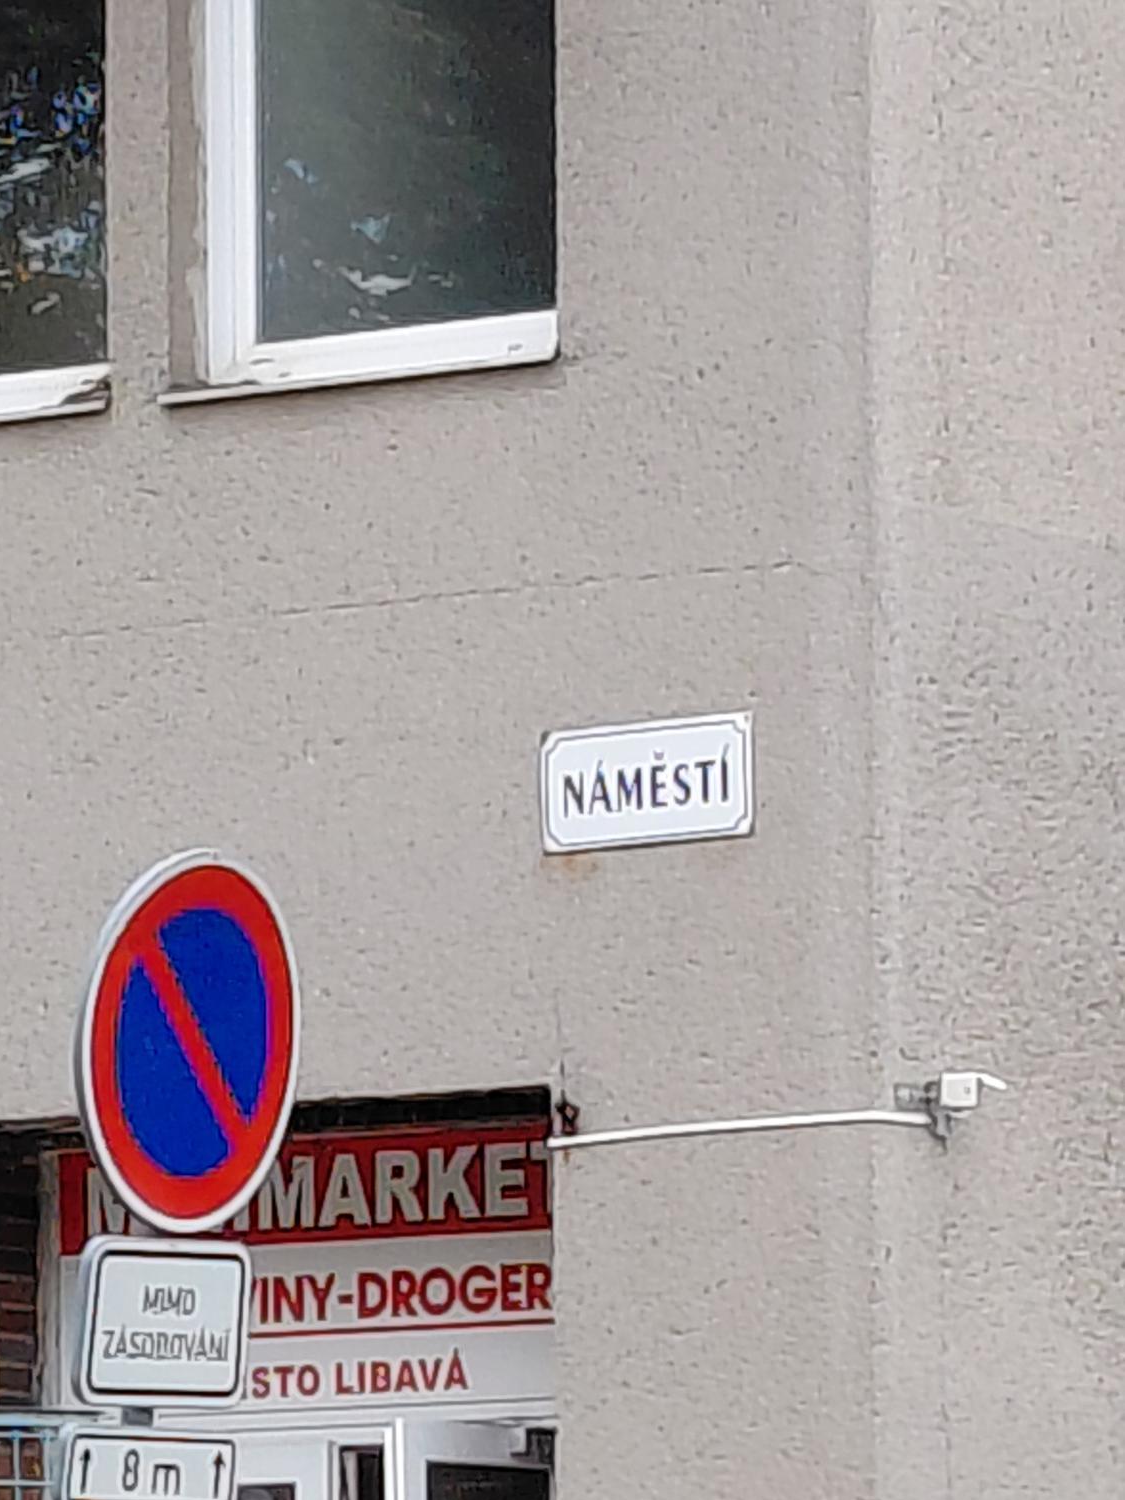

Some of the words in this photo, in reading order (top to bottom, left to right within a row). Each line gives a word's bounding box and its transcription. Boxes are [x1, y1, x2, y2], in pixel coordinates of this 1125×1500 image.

[562, 743, 730, 818] NÁMĚSTÍ
[142, 1285, 196, 1316] MIMO
[102, 1324, 231, 1361] ZÁSOBOVÁNÍ
[242, 1362, 320, 1400] STO
[335, 1347, 469, 1395] LIBAVÁ
[122, 1448, 140, 1492] 8
[151, 1462, 181, 1496] m
